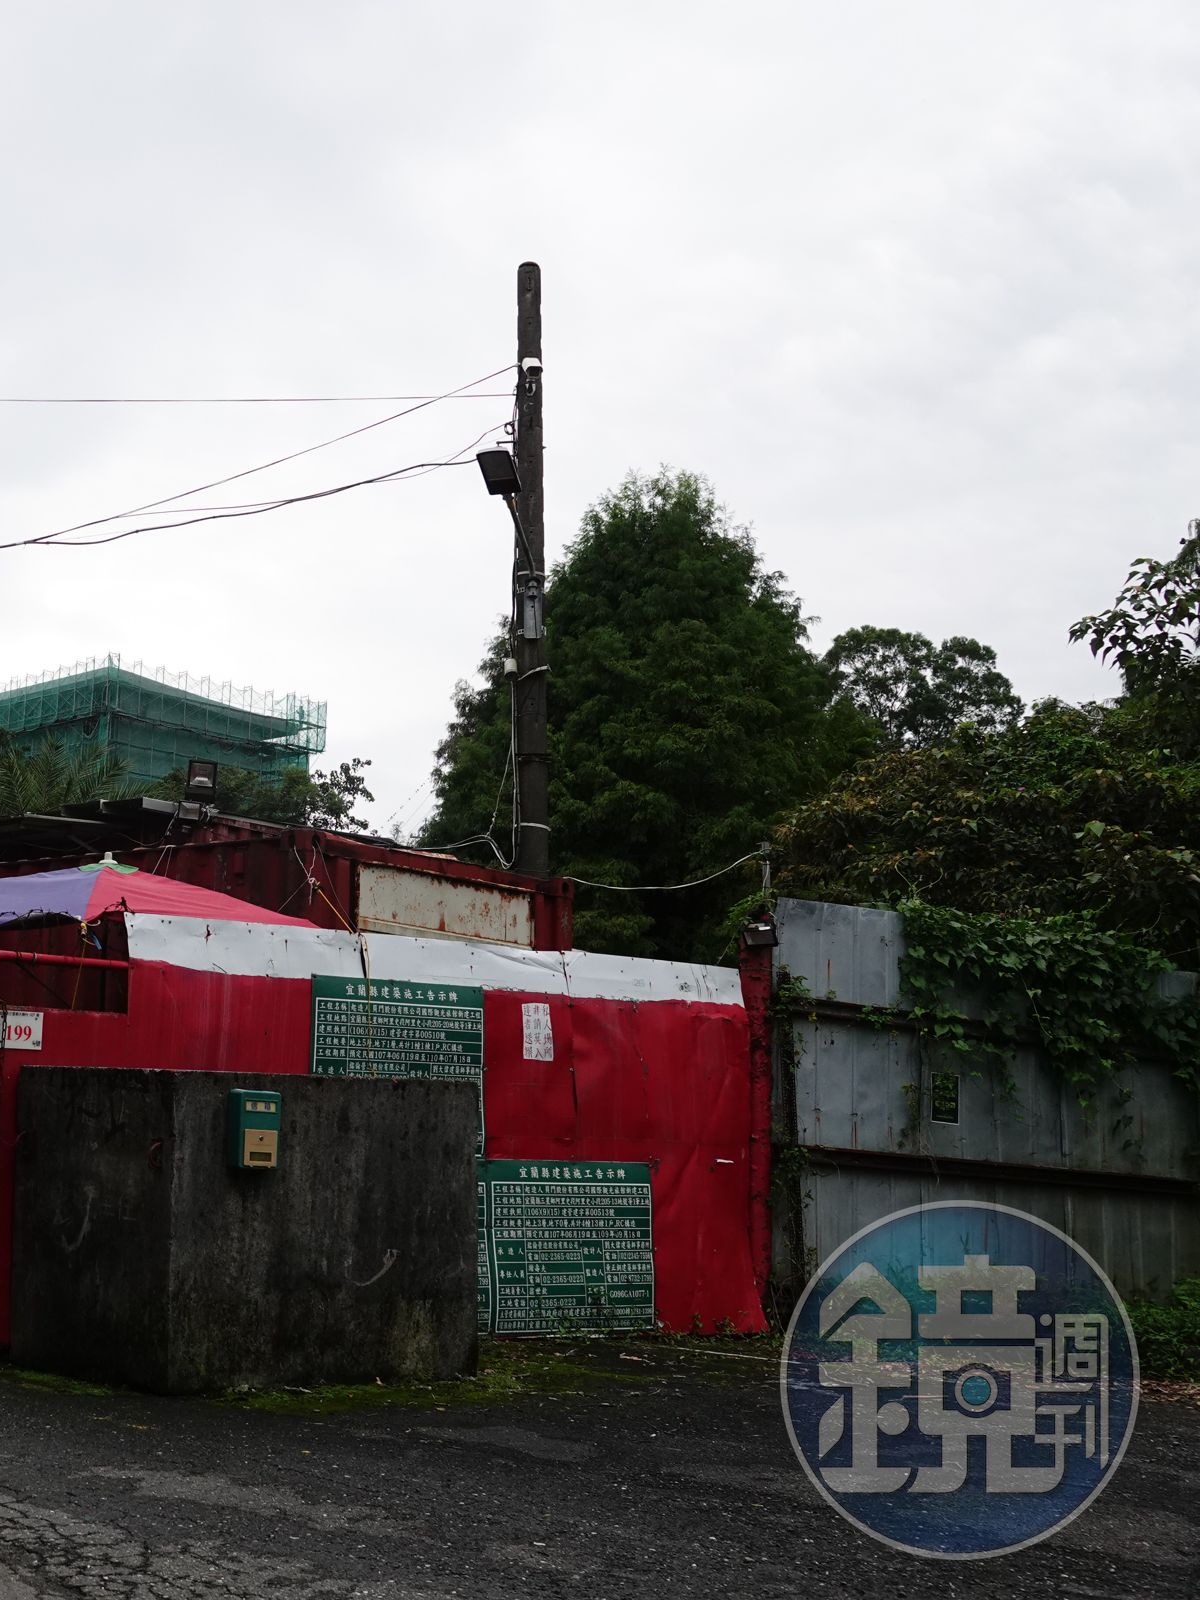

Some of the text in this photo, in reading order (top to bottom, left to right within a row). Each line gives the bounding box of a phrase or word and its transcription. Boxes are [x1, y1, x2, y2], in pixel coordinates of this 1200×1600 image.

[345, 984, 458, 1003] 宜蘭縣建築施工告示牌
[6, 1025, 32, 1041] 199
[519, 1166, 626, 1180] 宜蘭縣建築施工告示牌
